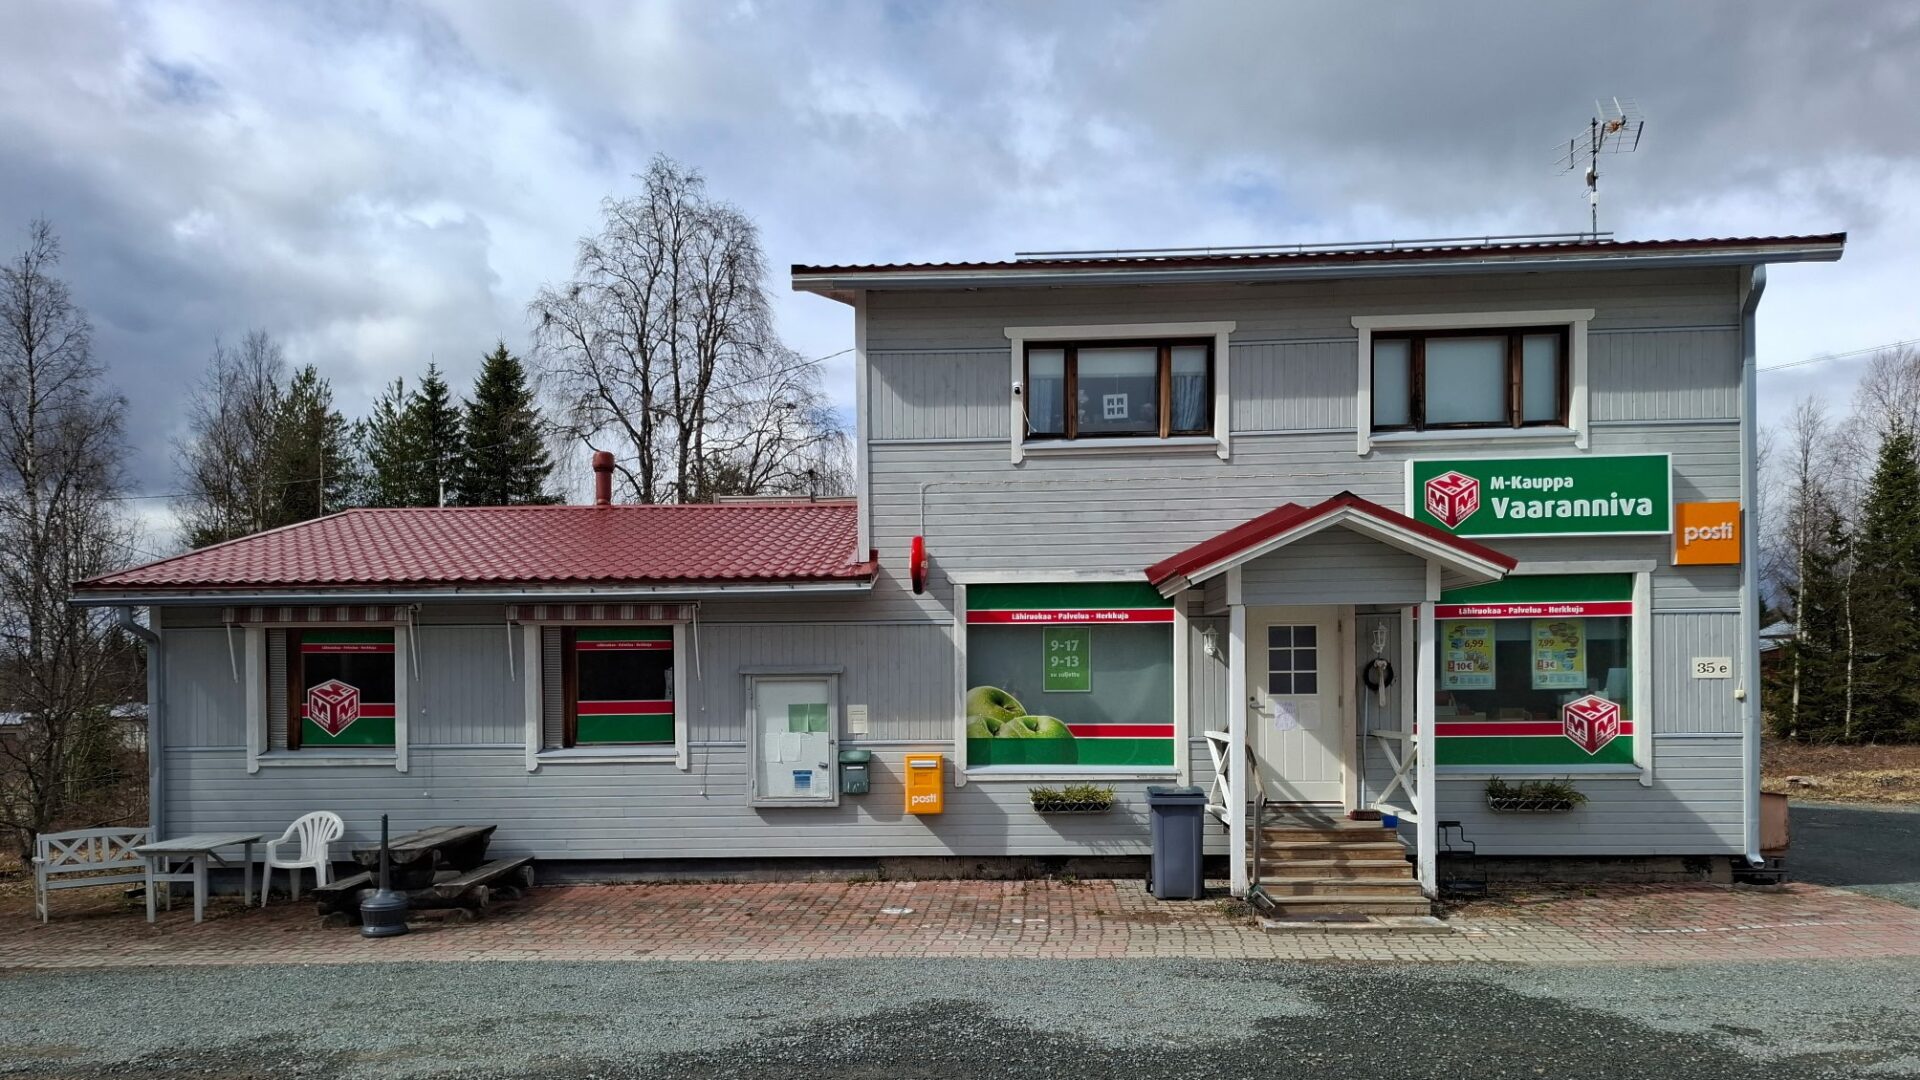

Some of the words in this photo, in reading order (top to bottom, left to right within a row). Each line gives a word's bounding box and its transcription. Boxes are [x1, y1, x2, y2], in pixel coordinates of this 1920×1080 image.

[1490, 474, 1574, 492] M-Kauppa
[1491, 492, 1653, 519] Vaaranniva
[1684, 522, 1733, 545] posti
[1011, 612, 1052, 620] Lähiruokaa
[1058, 612, 1090, 620] Palvelua
[1095, 612, 1129, 620] Herkkuja
[1459, 607, 1502, 615] Lähiruokaa
[1508, 607, 1542, 615] Palvelua
[1548, 605, 1584, 614] Herkkuja
[1050, 639, 1079, 651] 9-17
[1464, 639, 1484, 649] 6,99
[1050, 655, 1079, 667] 9-13
[1456, 662, 1473, 670] 10€
[1697, 662, 1715, 673] 35
[1719, 664, 1728, 673] e
[911, 793, 937, 807] posti
